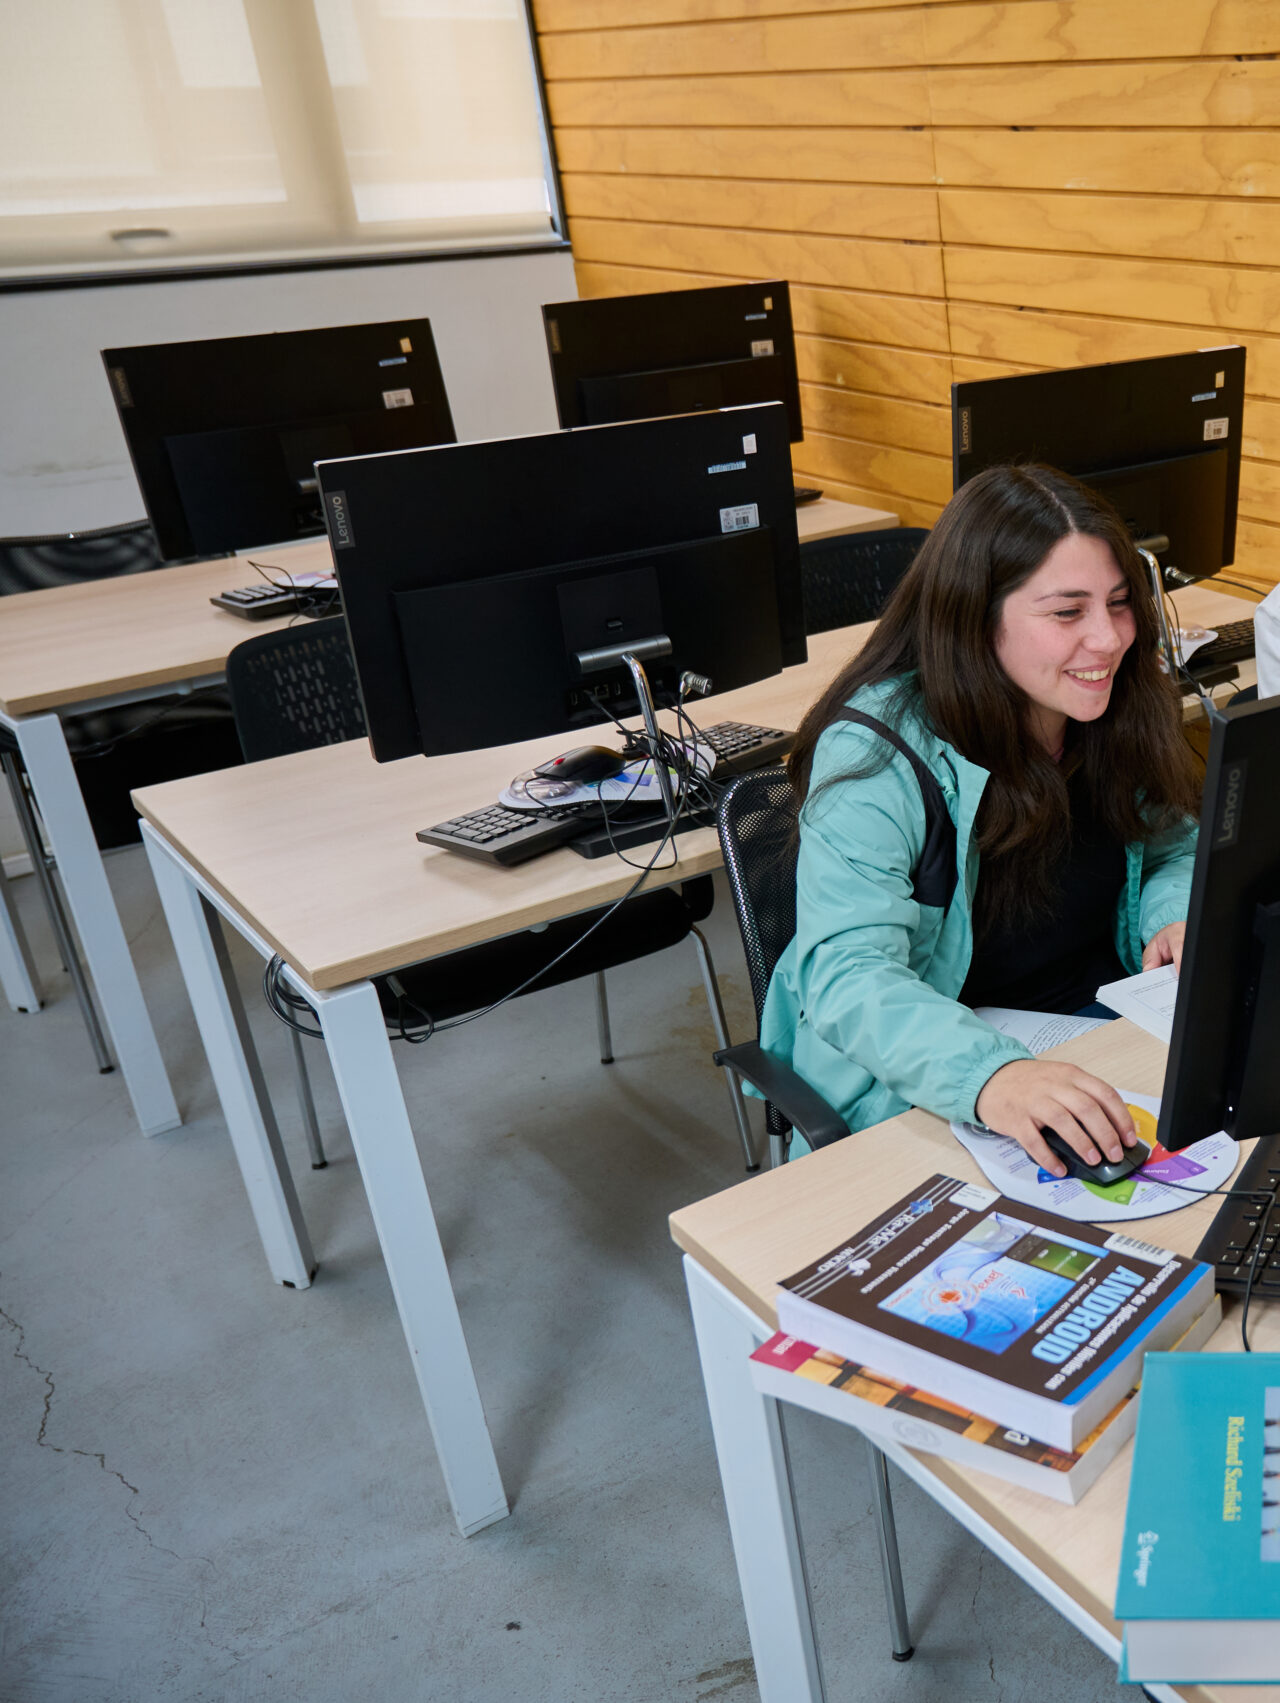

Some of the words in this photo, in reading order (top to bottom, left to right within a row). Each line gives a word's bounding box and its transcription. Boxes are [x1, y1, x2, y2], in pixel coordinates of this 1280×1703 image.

[961, 411, 969, 450] Lenovo
[333, 496, 350, 545] Lenovo
[1217, 768, 1241, 843] Lenovo
[976, 1269, 1004, 1291] Java
[1131, 1294, 1147, 1306] de
[1140, 1260, 1182, 1297] Desarrollo
[1031, 1264, 1146, 1364] ANDROID
[1089, 1303, 1138, 1349] Aplicaciones
[1044, 1373, 1066, 1390] con
[1226, 1416, 1245, 1466] Richard
[1222, 1467, 1243, 1522] Szeliski
[1133, 1545, 1154, 1587] Springer
